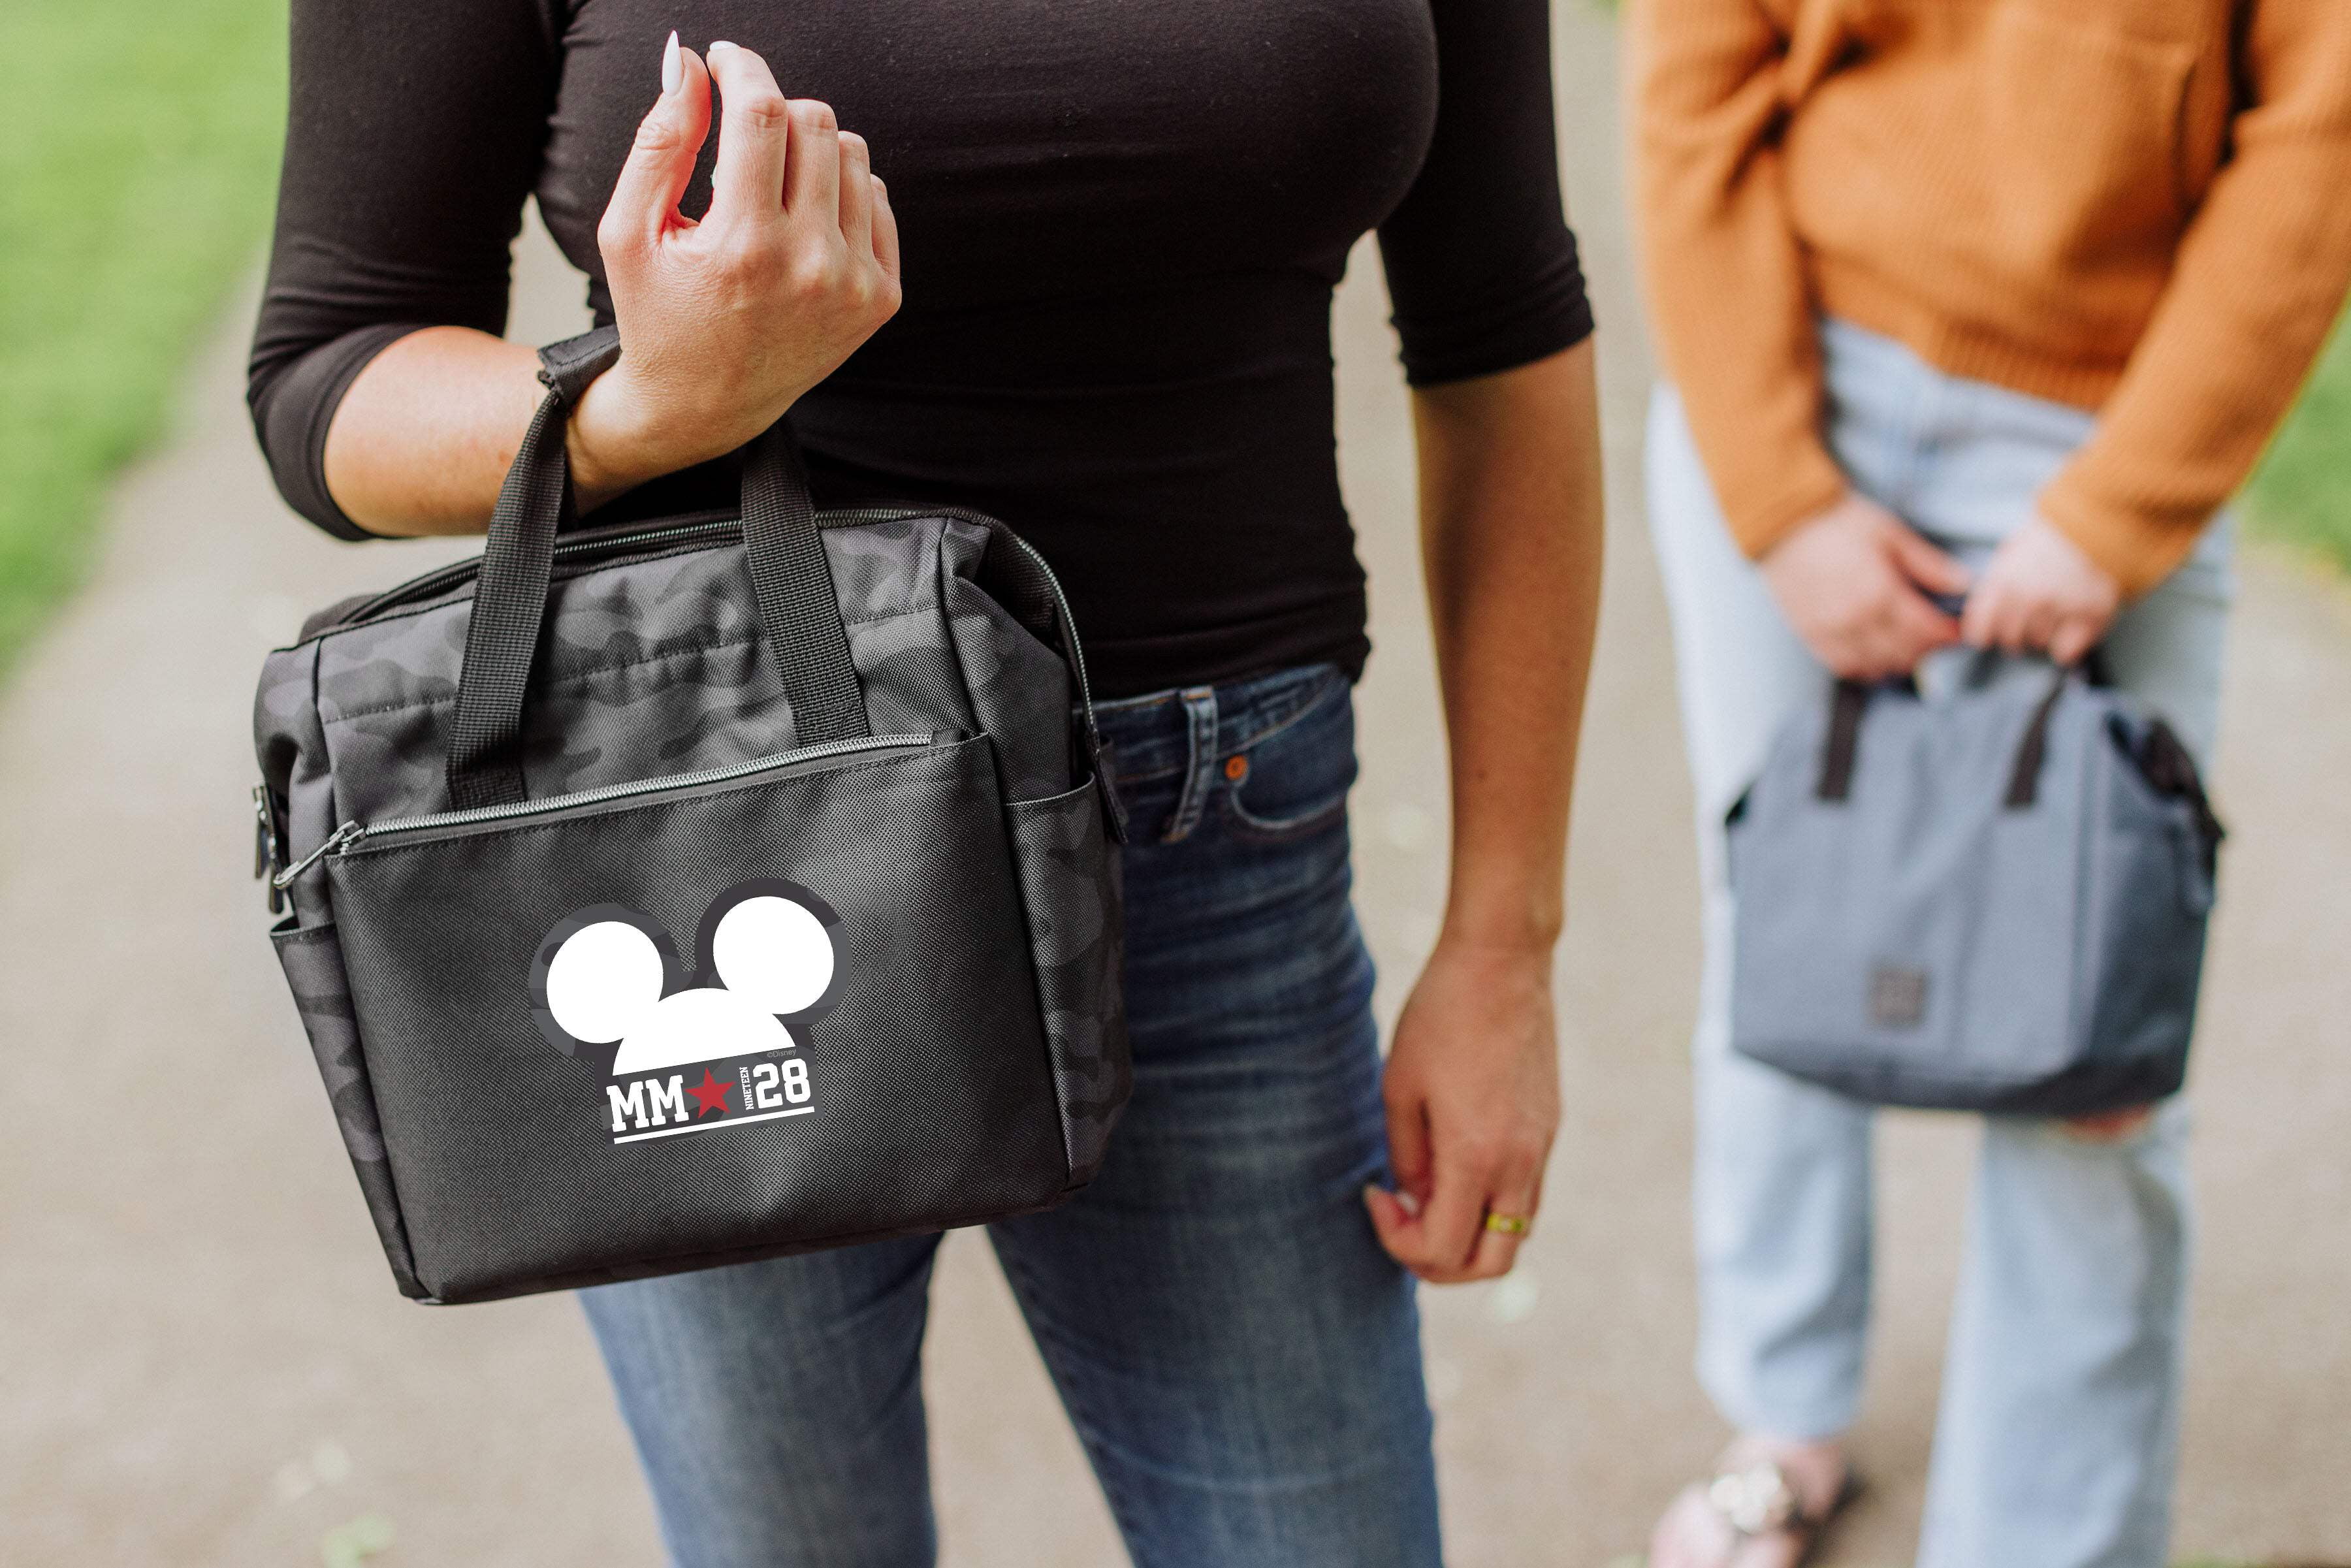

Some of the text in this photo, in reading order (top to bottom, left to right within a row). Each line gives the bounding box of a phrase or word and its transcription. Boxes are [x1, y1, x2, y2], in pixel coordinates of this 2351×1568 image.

[606, 1058, 811, 1132] MM NINETEEN 28
